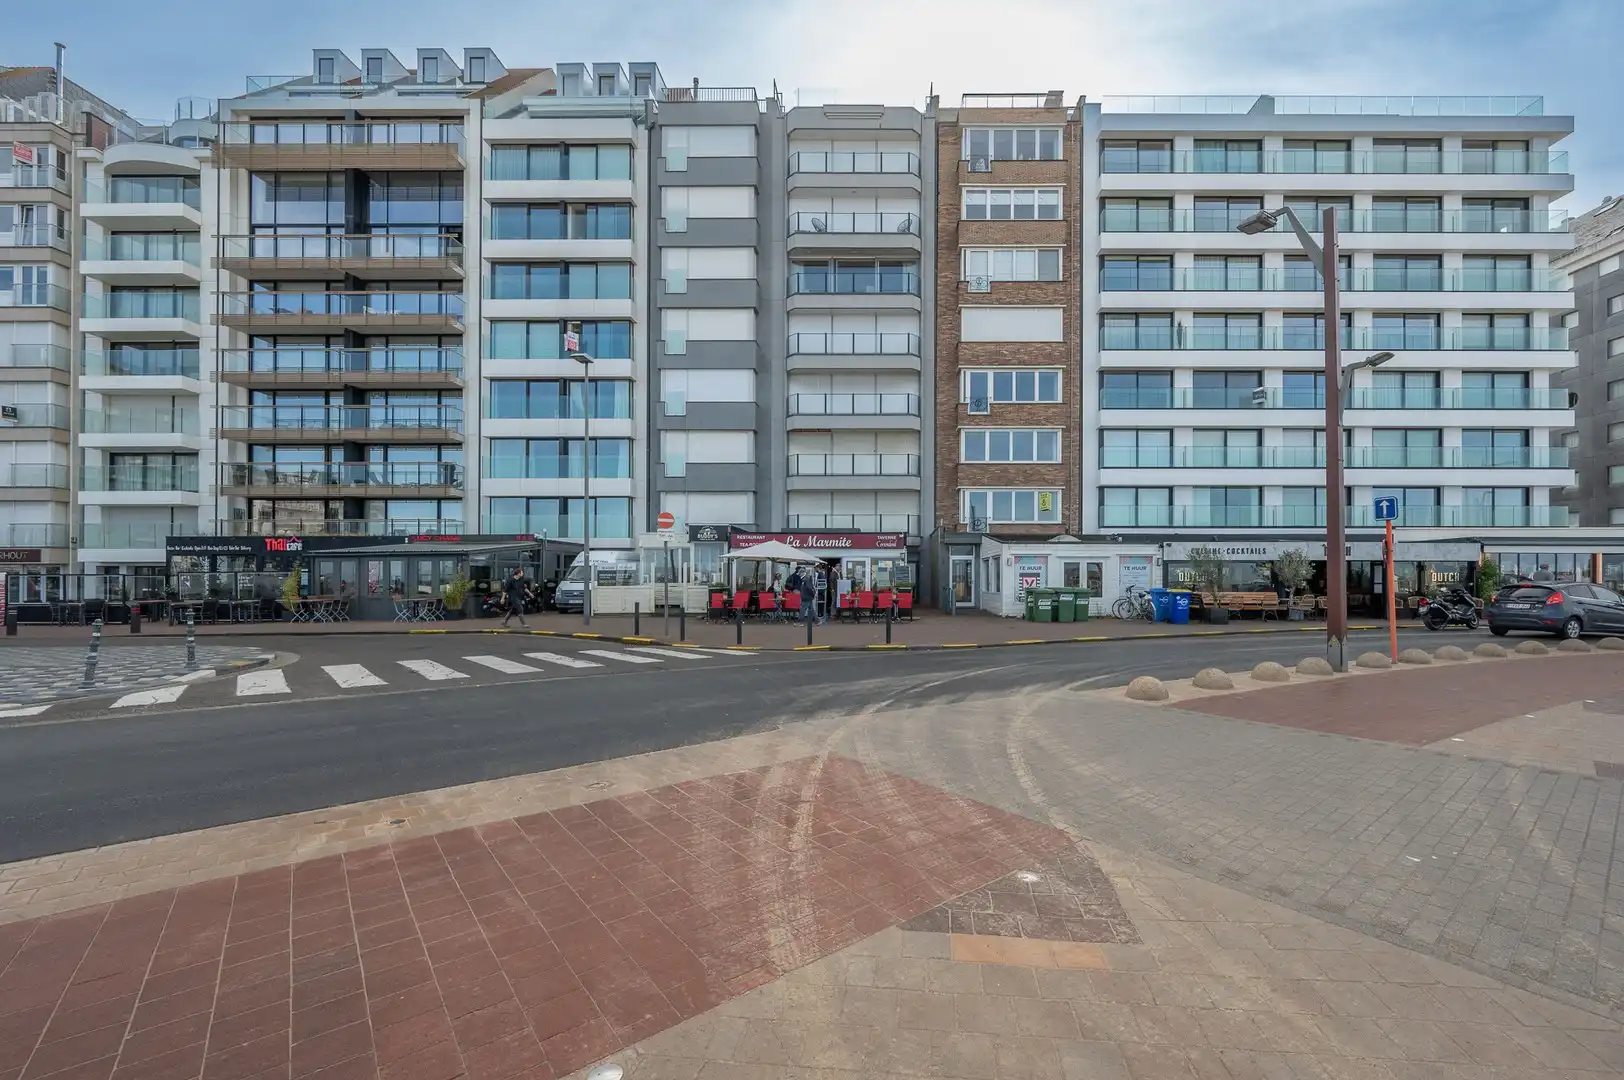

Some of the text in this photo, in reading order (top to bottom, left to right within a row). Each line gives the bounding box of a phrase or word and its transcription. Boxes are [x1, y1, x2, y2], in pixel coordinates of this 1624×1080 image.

[264, 537, 287, 552] Thai
[786, 535, 853, 548] La Marmite
[1226, 547, 1267, 555] COCKTAILS
[1431, 572, 1460, 582] DUTCH
